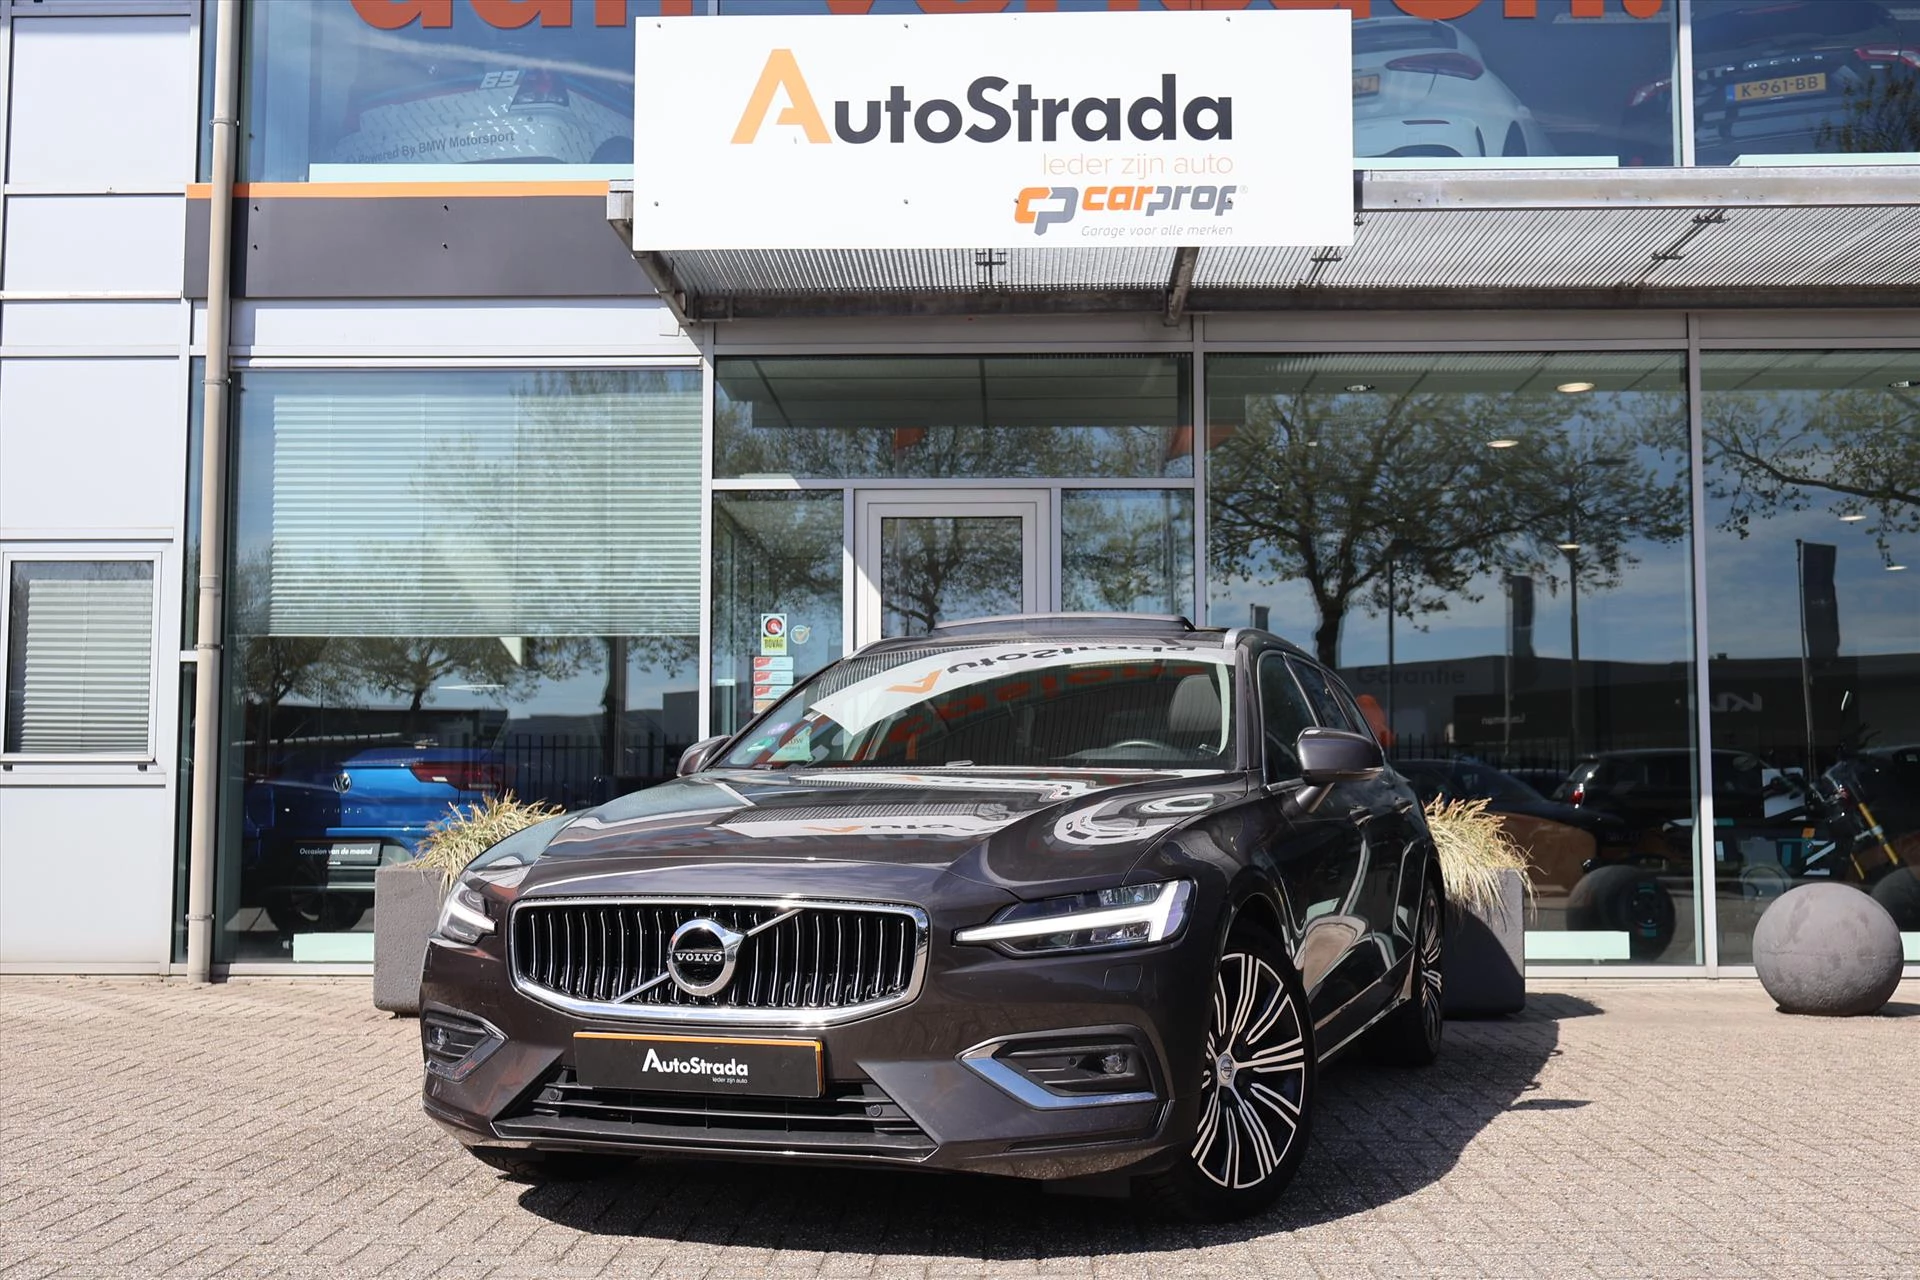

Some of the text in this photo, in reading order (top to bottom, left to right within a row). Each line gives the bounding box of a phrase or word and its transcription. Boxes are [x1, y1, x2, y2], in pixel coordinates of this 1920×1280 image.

[480, 70, 520, 90] 69
[1741, 76, 1819, 98] K-961-BB
[730, 48, 1233, 145] AutoStrada
[358, 131, 516, 164] Powered By BMW Motorsport
[1043, 153, 1234, 179] Ieder zijn auto
[1082, 185, 1237, 216] carprof
[1081, 224, 1233, 238] Garage voor alle merken
[300, 847, 327, 855] Occasion
[341, 847, 349, 855] de
[350, 847, 374, 855] maand
[675, 952, 722, 962] VOLVO
[641, 1048, 749, 1076] AutoStrada
[726, 1077, 736, 1085] zijn
